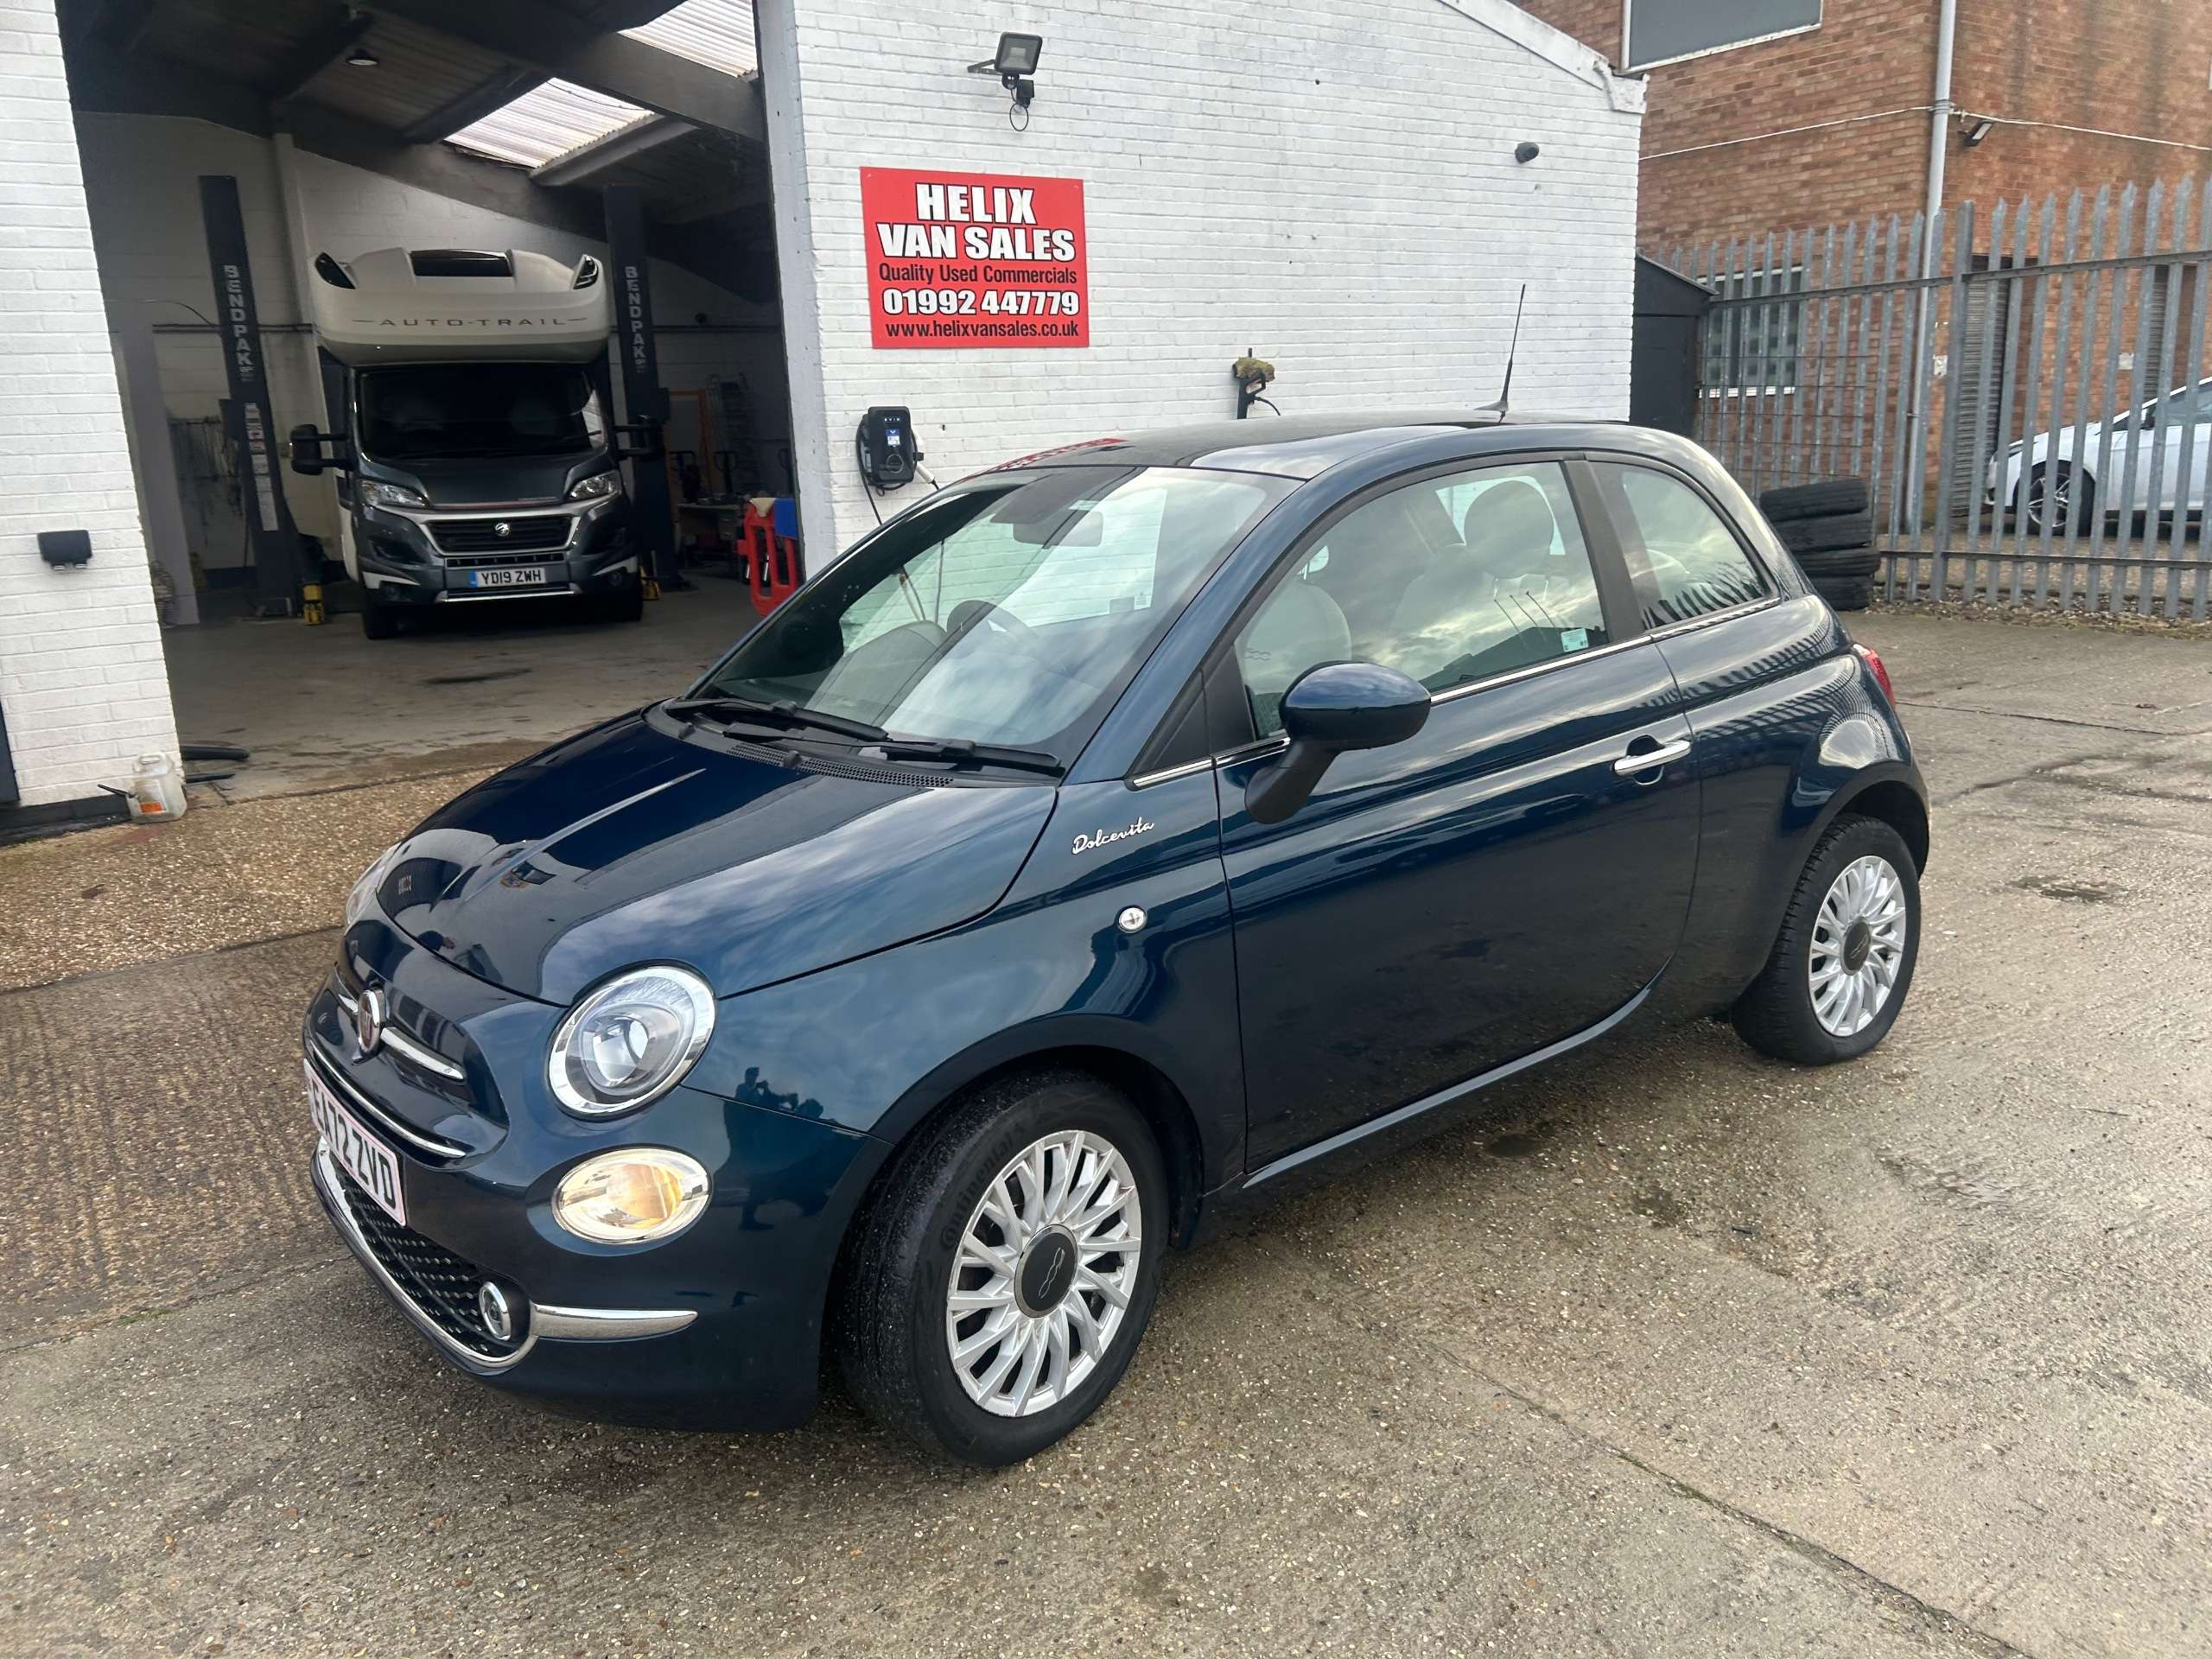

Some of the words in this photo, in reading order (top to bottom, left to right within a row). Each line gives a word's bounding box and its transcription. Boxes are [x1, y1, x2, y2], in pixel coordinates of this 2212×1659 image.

[915, 182, 1038, 225] HELIX
[876, 222, 958, 259] VAN
[963, 226, 1076, 262] SALES
[879, 263, 934, 284] Quality
[940, 264, 977, 282] Used
[983, 265, 1077, 283] Commercials
[223, 264, 253, 365] BENDPAK
[625, 266, 646, 359] BENDPAK
[882, 288, 976, 315] 01992
[981, 289, 1079, 315] 447779
[886, 320, 1078, 337] www.helixvansales.co.uk
[481, 571, 512, 584] YD19
[515, 569, 542, 582] ZWH
[1071, 816, 1155, 855] Dolcevita
[352, 1127, 397, 1210] ZVD
